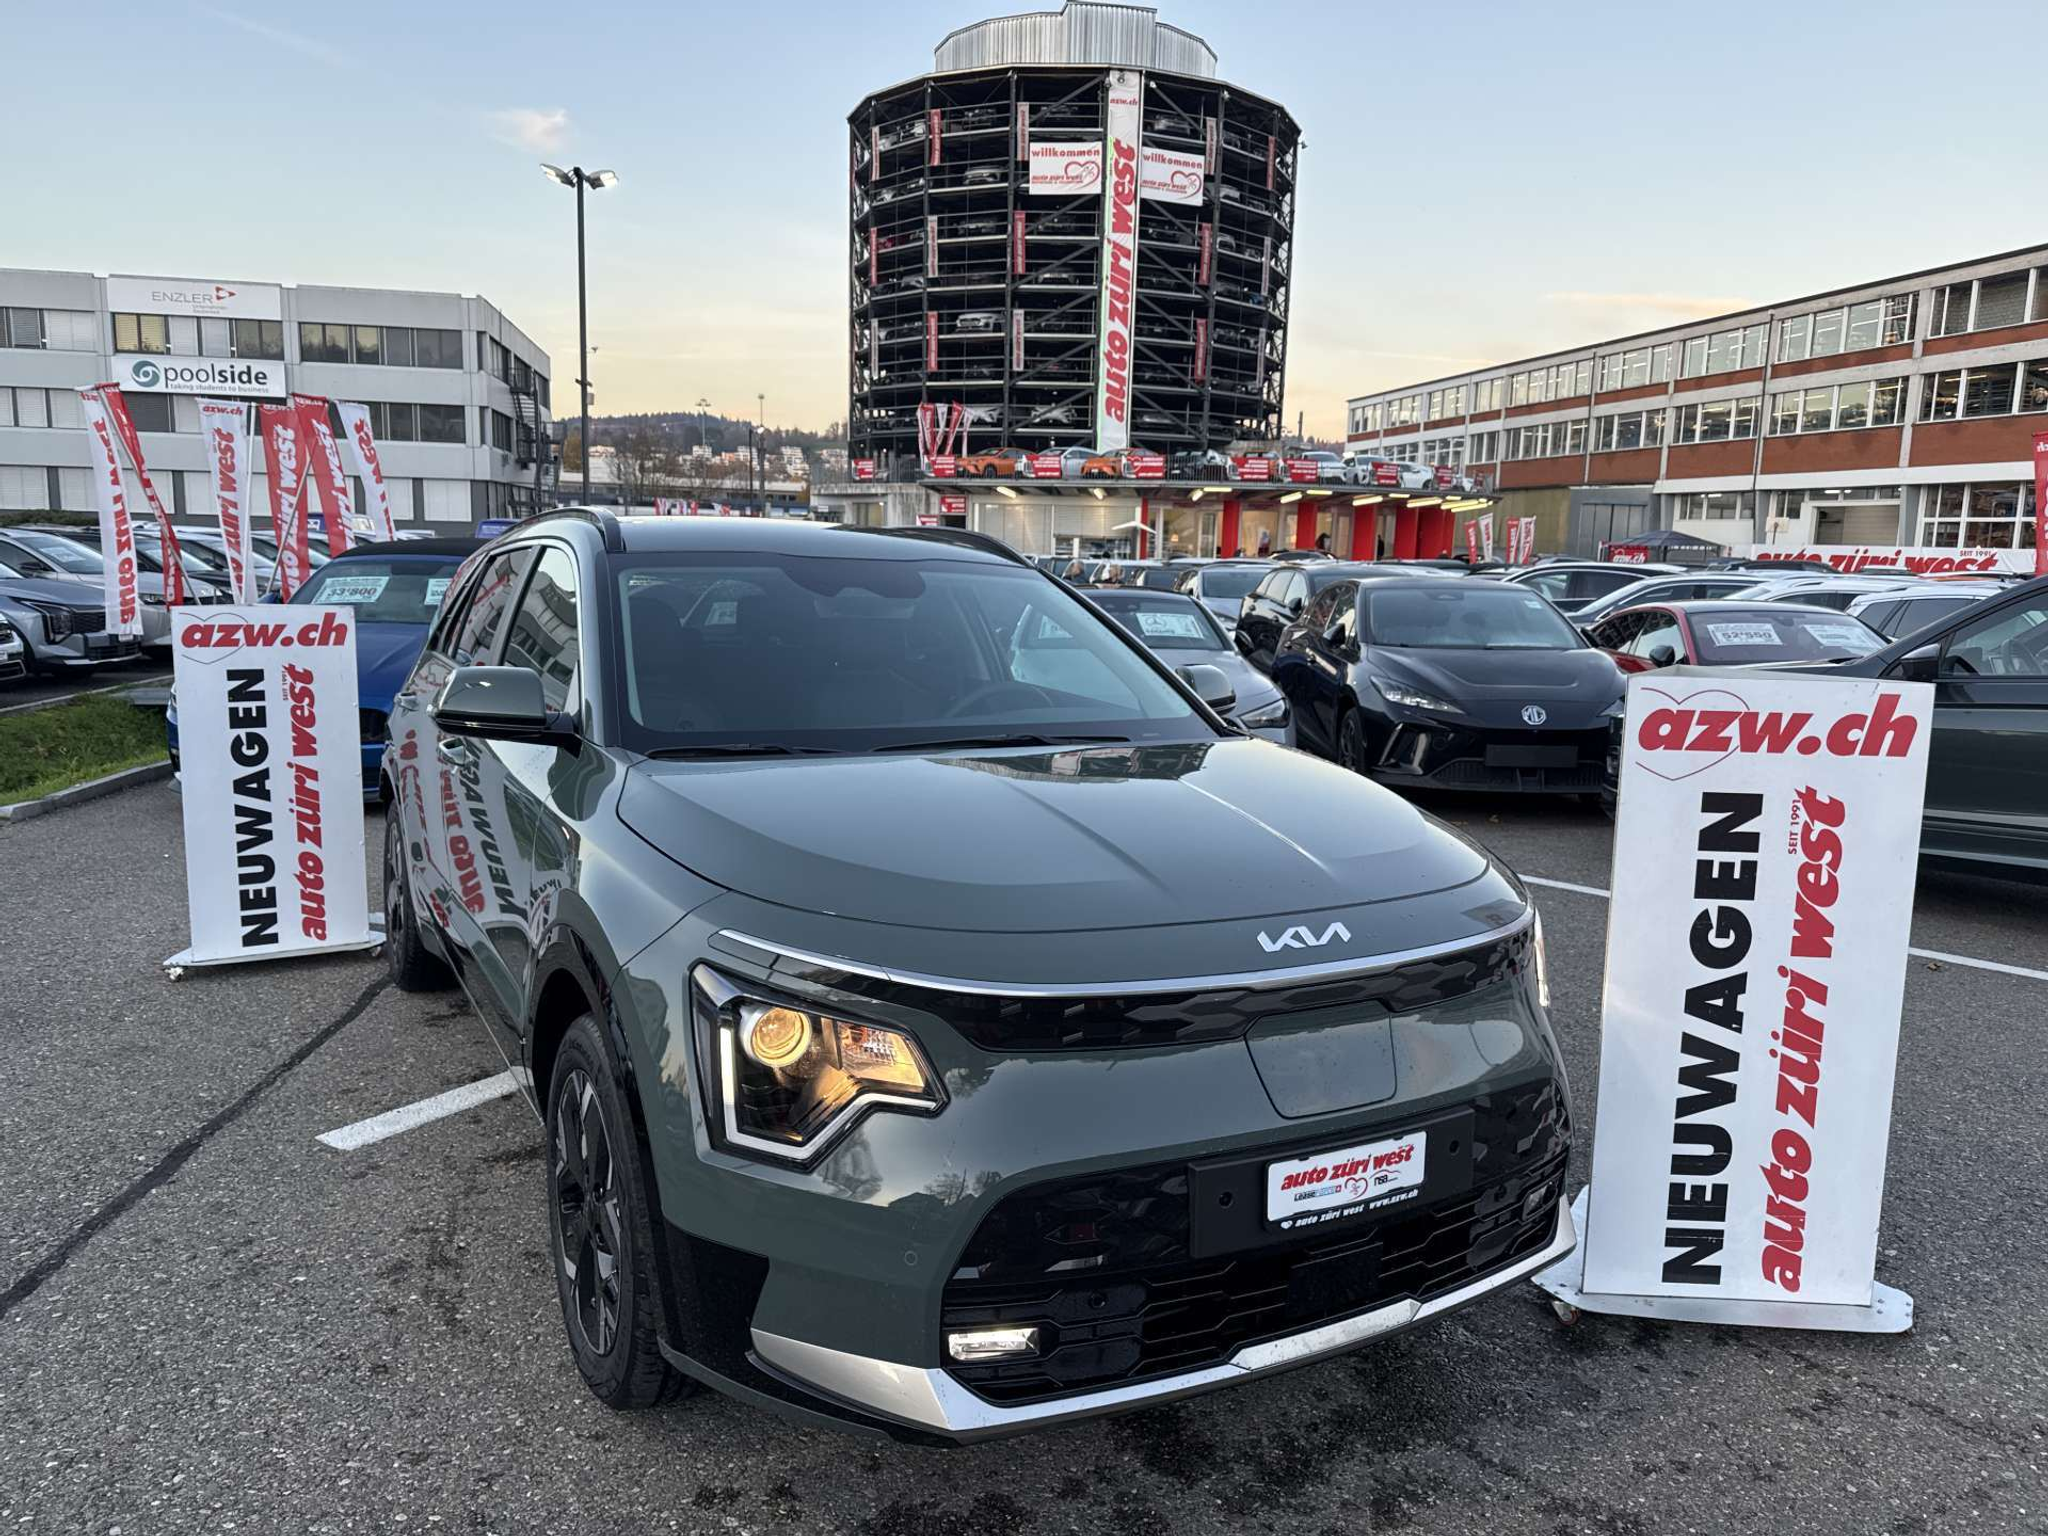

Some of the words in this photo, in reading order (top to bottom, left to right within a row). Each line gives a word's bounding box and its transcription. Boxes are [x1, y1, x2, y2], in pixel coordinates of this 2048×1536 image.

[1031, 147, 1100, 157] willkommen
[1142, 152, 1203, 169] willkommen
[1112, 137, 1135, 235] west
[152, 291, 213, 304] ENZLER
[1105, 238, 1132, 329] züri
[164, 363, 268, 389] poolside
[1104, 330, 1128, 424] auto
[202, 405, 244, 416] azw.ch
[213, 427, 237, 493] west
[273, 423, 298, 488] west
[311, 418, 346, 487] west
[180, 612, 348, 649] azw.ch
[282, 663, 318, 757] west
[1522, 706, 1546, 724] MG
[1638, 694, 1918, 758] azw.ch
[226, 668, 279, 948] NEUWAGEN
[287, 761, 323, 850] züri
[1790, 798, 1801, 829] 1991
[1788, 830, 1798, 855] SEIT
[1790, 785, 1846, 958] west
[293, 855, 327, 942] auto
[1256, 921, 1352, 952] KIA
[1661, 792, 1764, 1286] NEUWAGEN
[1768, 965, 1829, 1129] züri
[1280, 1164, 1328, 1191] auto
[1328, 1154, 1372, 1181] züri
[1372, 1143, 1415, 1170] west
[1295, 1215, 1318, 1228] auto
[1319, 1209, 1341, 1222] züri
[1342, 1204, 1365, 1217] west
[1759, 1128, 1812, 1293] auto
